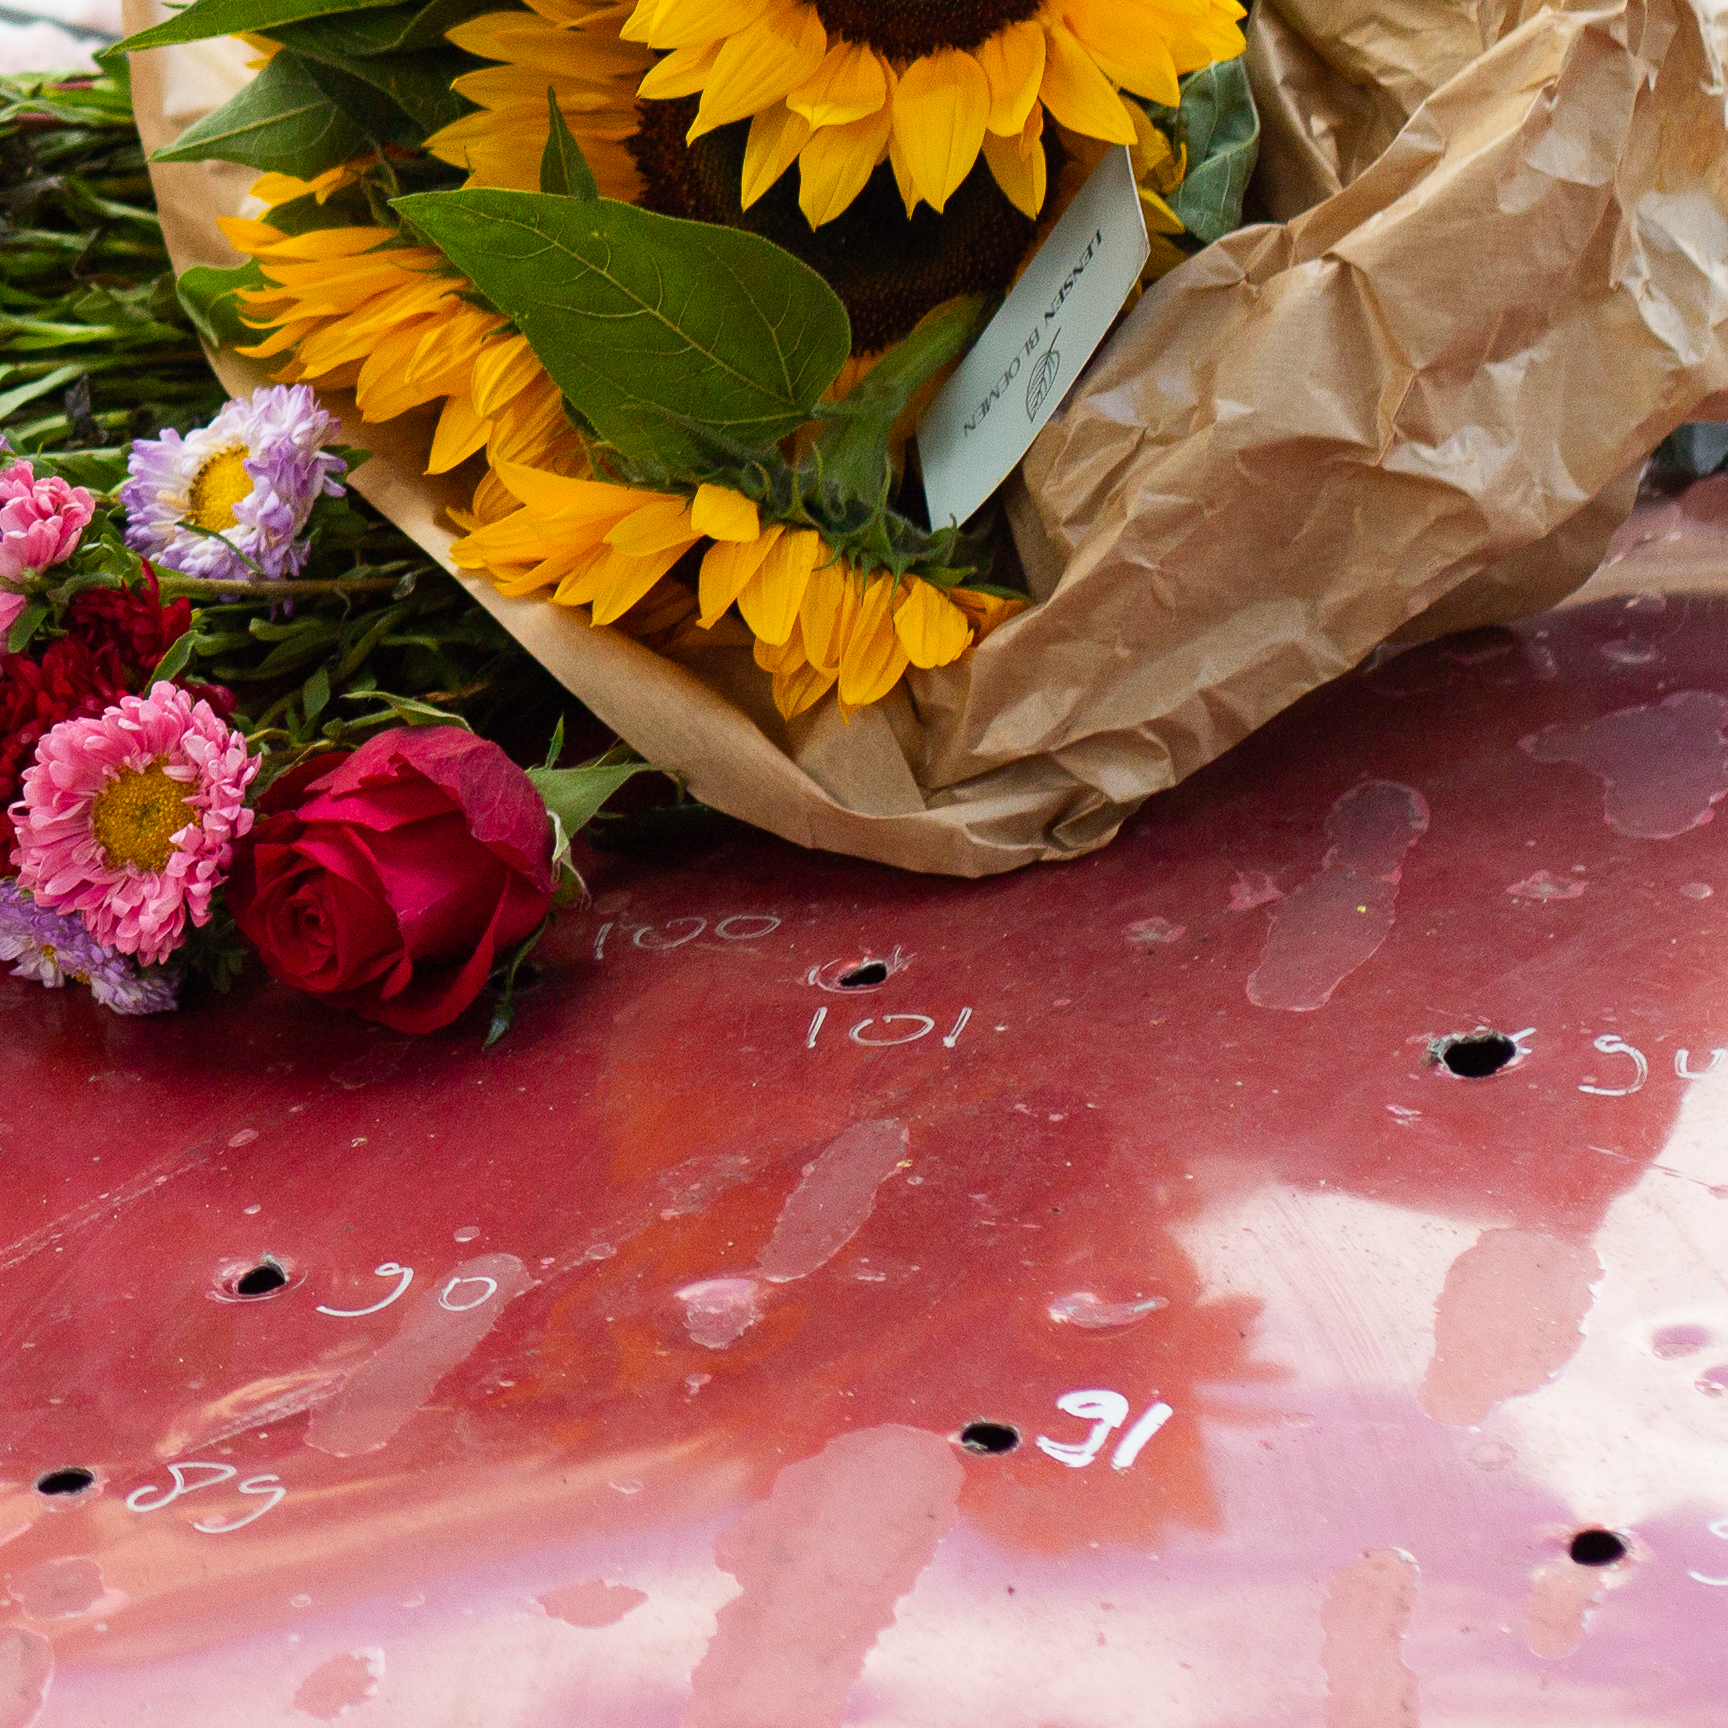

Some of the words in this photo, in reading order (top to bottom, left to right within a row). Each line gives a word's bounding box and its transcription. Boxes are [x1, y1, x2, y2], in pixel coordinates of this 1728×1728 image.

[1043, 228, 1103, 329] LENSEN
[964, 326, 1041, 436] BLOEMEN
[593, 913, 782, 962] 100
[805, 1005, 975, 1049] 101
[316, 1260, 498, 1317] 90
[1035, 1388, 1174, 1470] 91
